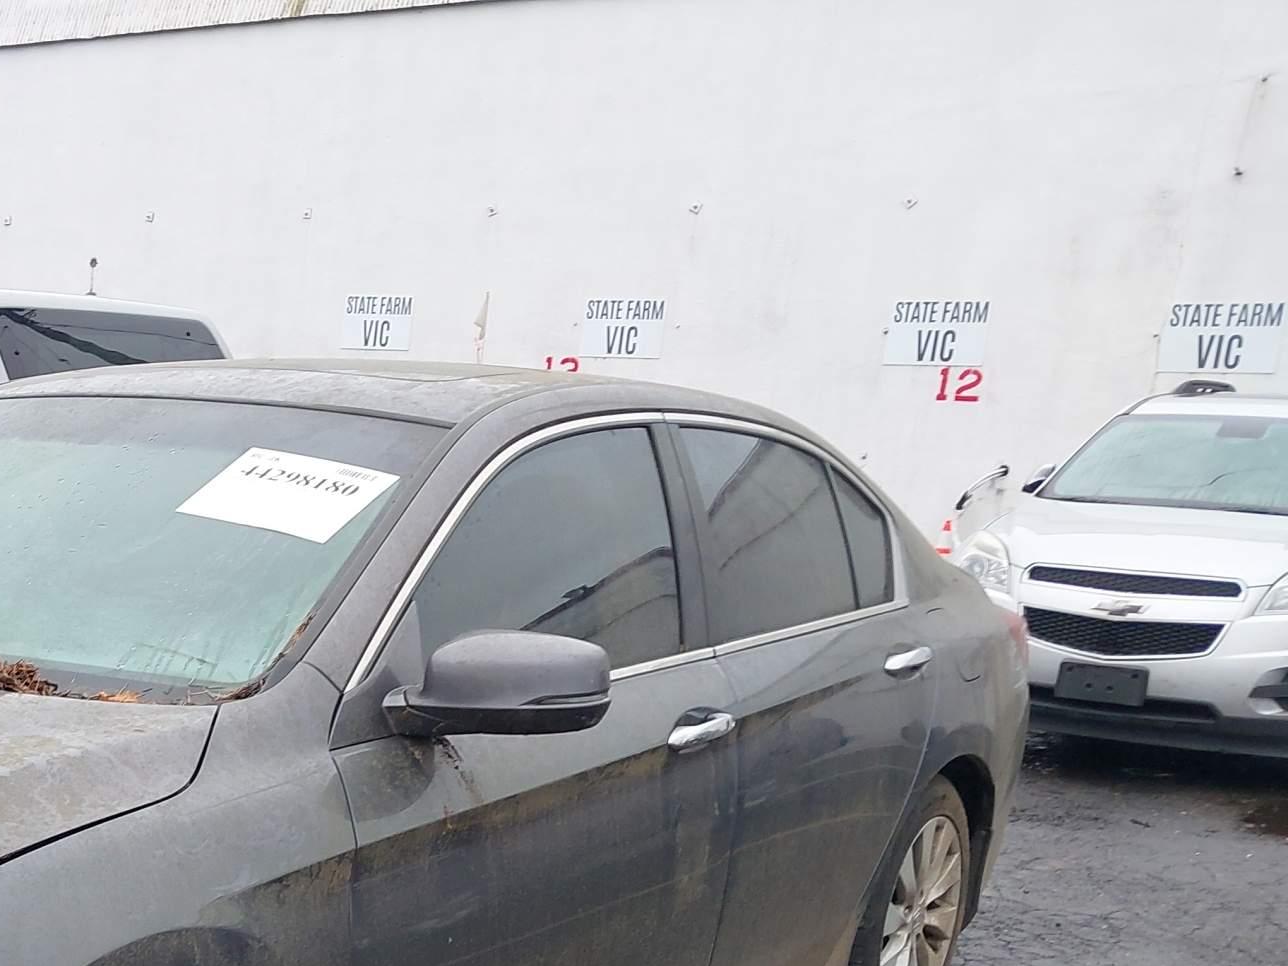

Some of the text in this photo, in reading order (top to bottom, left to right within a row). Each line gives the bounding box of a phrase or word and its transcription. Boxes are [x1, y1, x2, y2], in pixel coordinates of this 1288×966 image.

[346, 295, 413, 315] STATE FARM
[586, 299, 665, 320] STATE FARM
[893, 300, 990, 323] STATE FARM
[1170, 302, 1286, 327] STATE FARM
[363, 319, 391, 347] VIC
[606, 325, 638, 355] VIC
[916, 329, 956, 362] VIC
[1198, 334, 1244, 369] VIC
[935, 366, 984, 402] 12
[240, 464, 361, 497] 44298180
